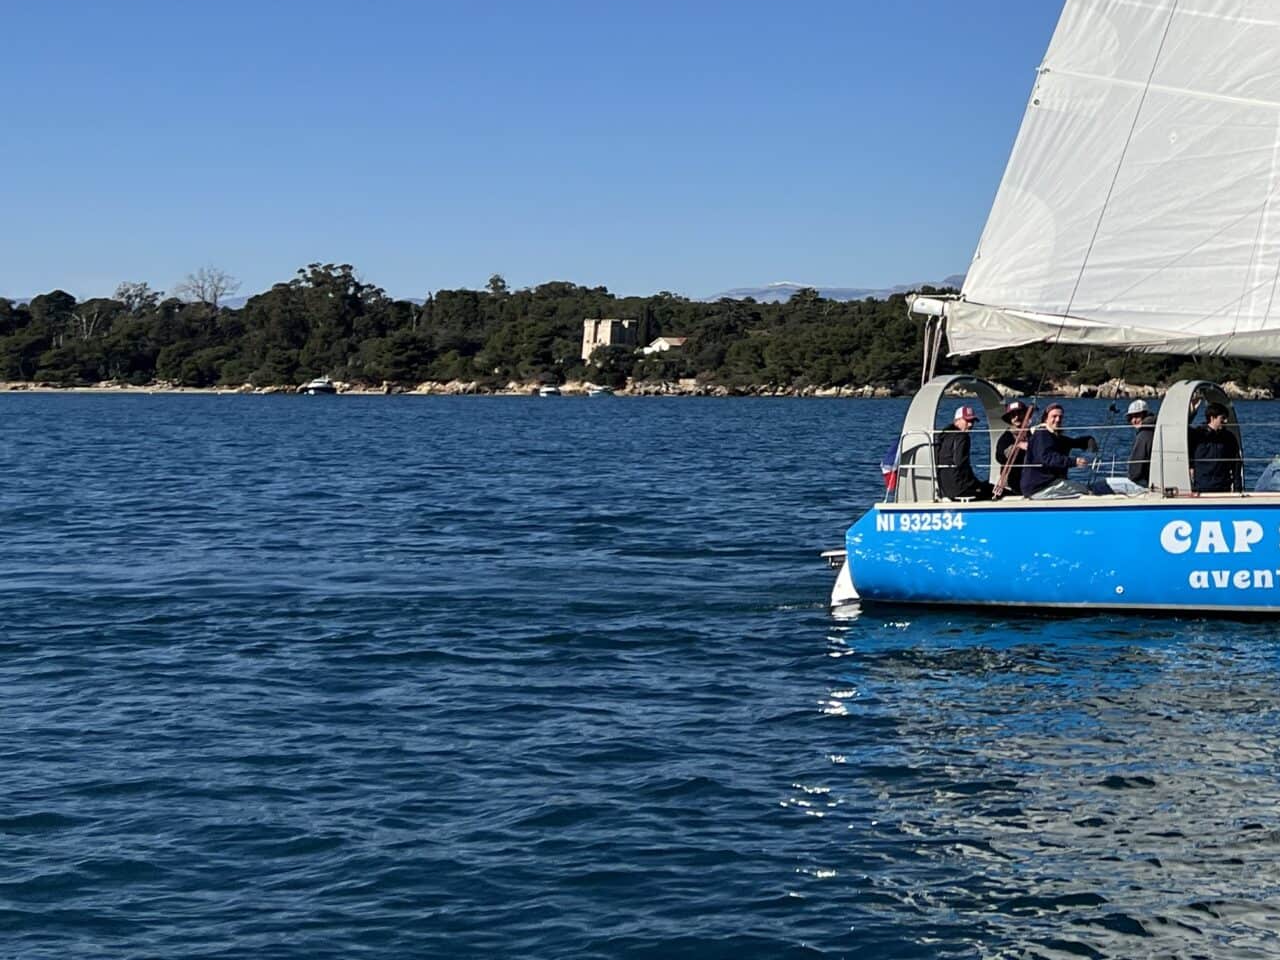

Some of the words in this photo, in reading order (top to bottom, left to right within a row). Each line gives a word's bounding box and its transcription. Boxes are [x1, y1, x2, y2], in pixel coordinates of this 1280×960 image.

[876, 513, 895, 531] NI
[899, 512, 965, 531] 932534
[1160, 519, 1264, 554] CAP
